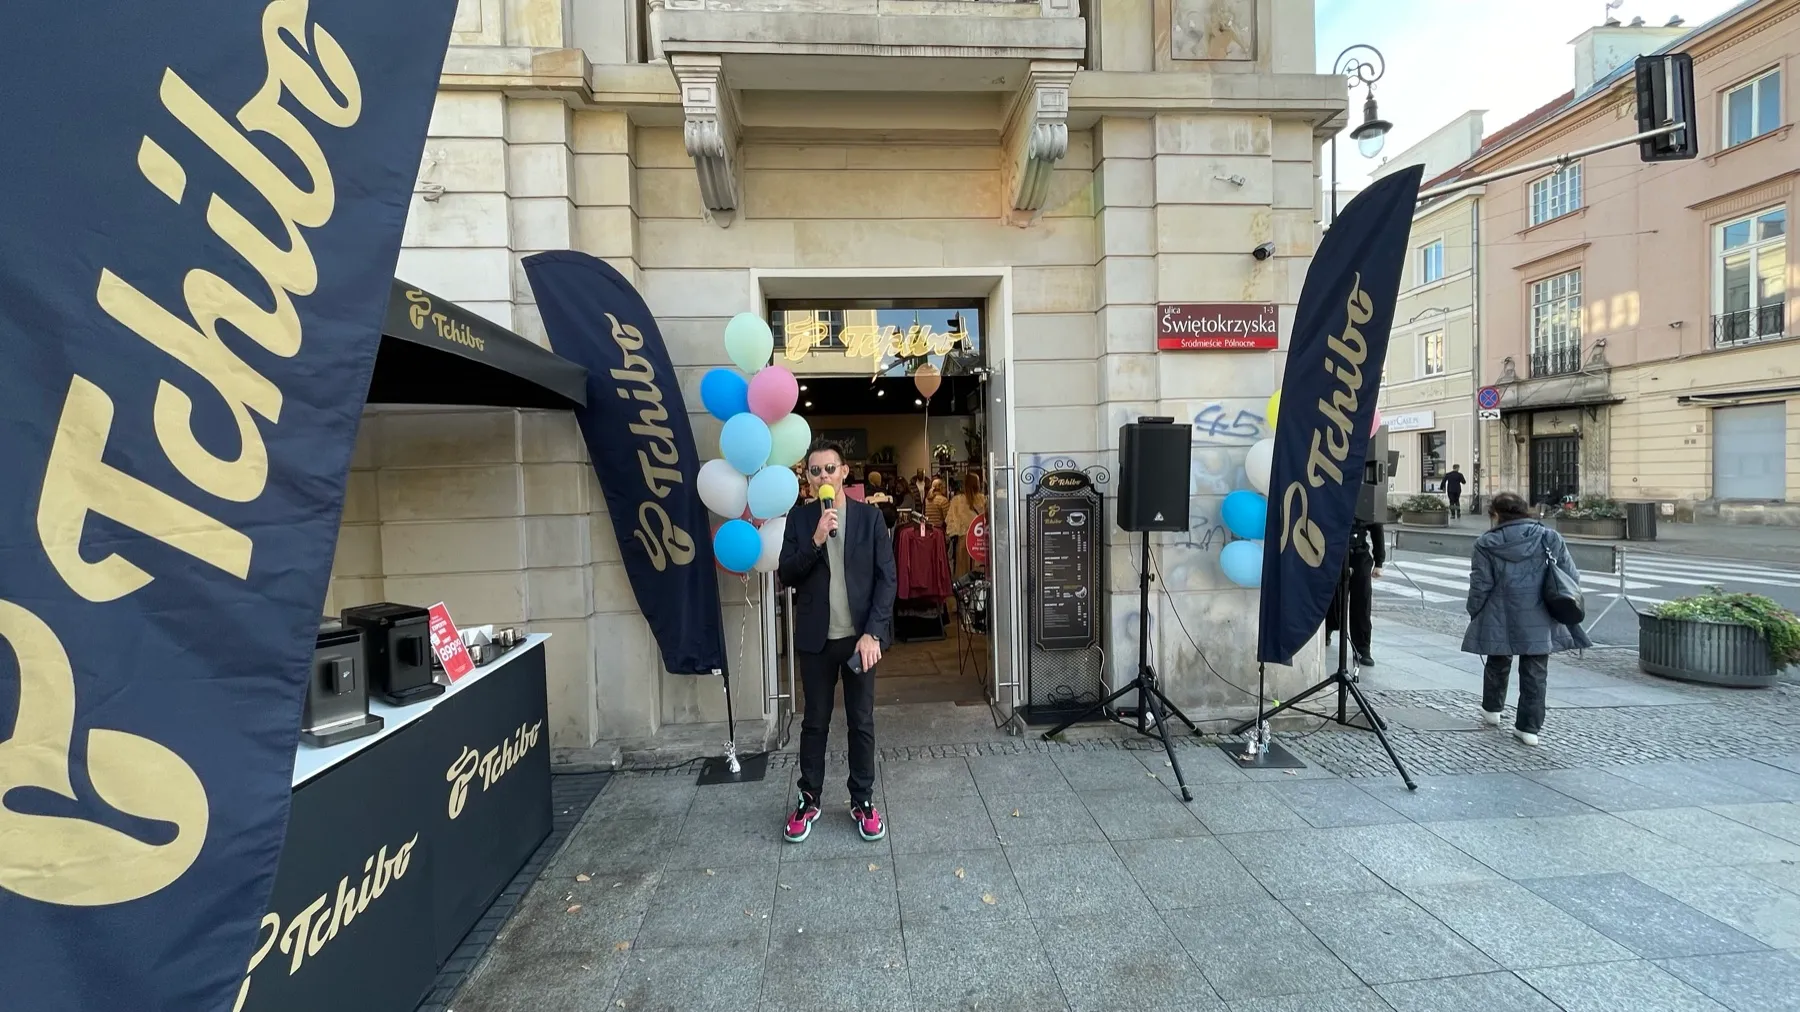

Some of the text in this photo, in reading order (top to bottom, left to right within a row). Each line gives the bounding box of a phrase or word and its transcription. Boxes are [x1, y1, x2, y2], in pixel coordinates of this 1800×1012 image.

[37, 0, 362, 603] Tchibo
[1162, 313, 1276, 338] Świętokrzyska
[1164, 306, 1274, 314] ulica 1-3
[432, 312, 484, 352] Tchibo
[838, 325, 967, 359] Tchibo
[1181, 338, 1256, 348] Śródmieście Północne
[604, 313, 683, 499] Tchibo
[1307, 272, 1374, 488] Tchibo
[478, 719, 542, 792] Tchibo
[280, 832, 418, 976] Tchibo
